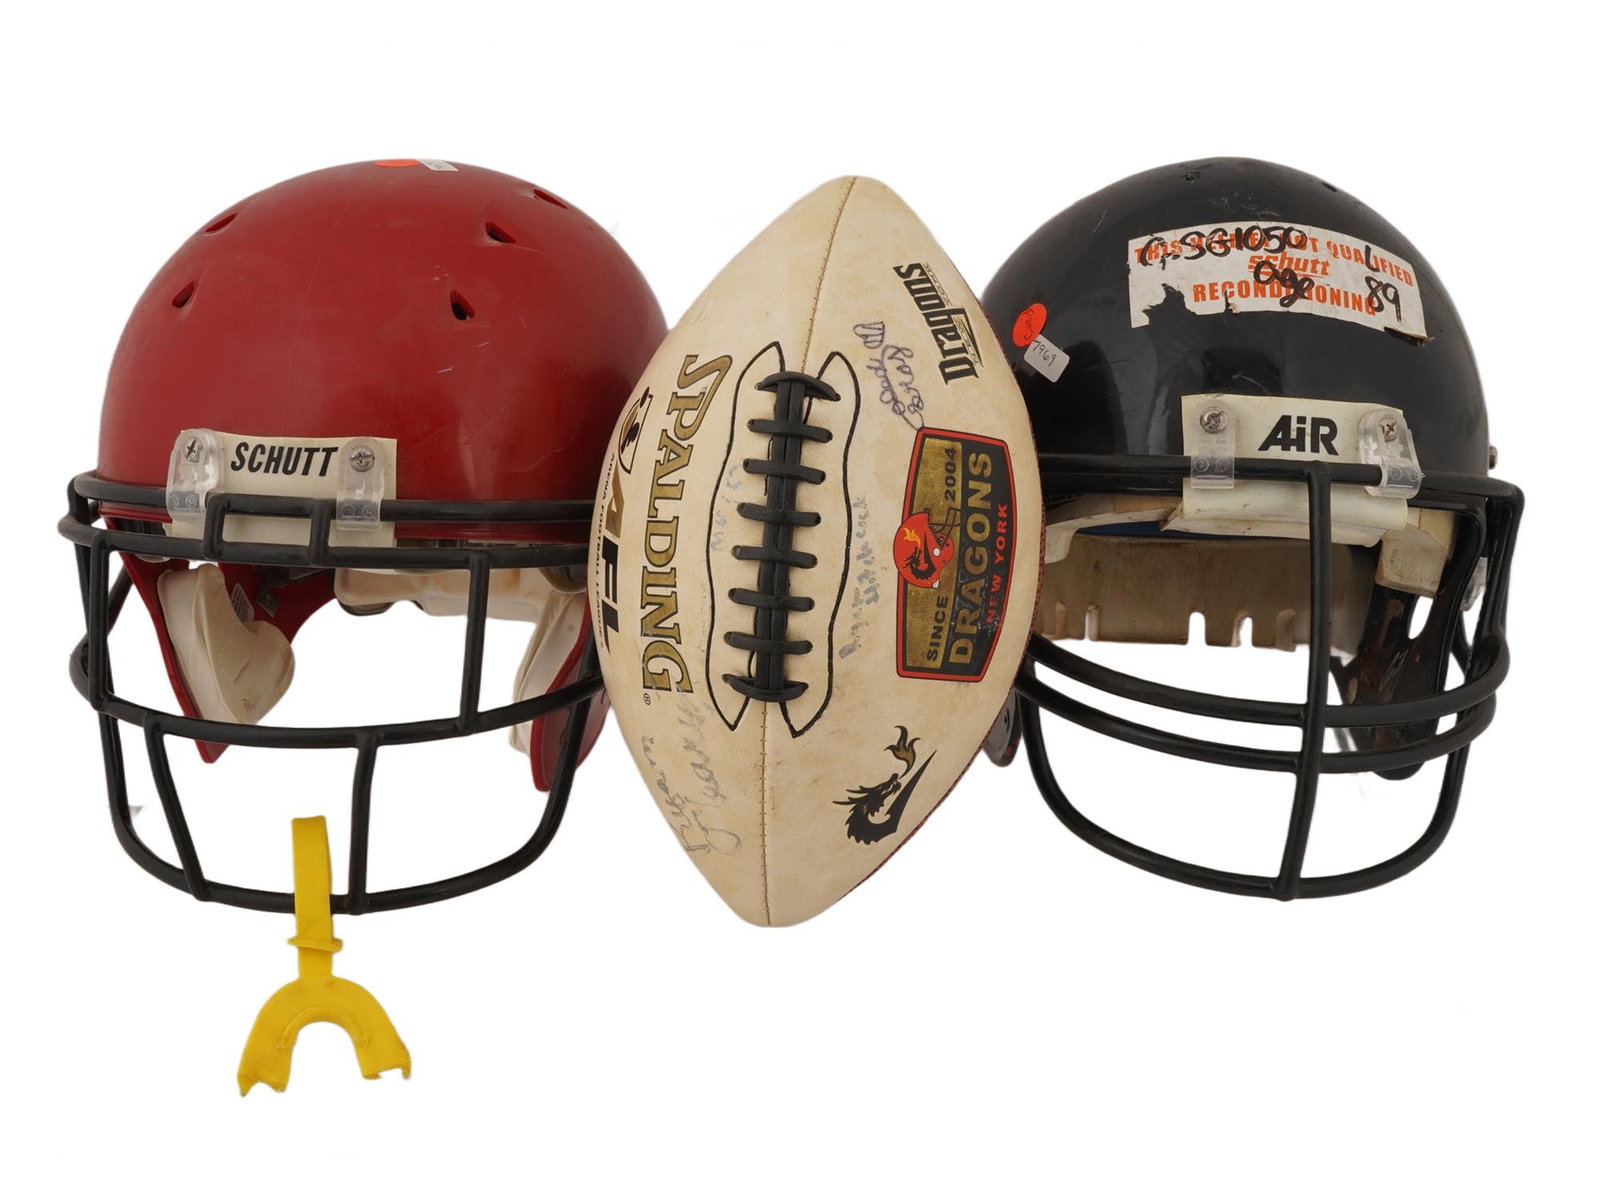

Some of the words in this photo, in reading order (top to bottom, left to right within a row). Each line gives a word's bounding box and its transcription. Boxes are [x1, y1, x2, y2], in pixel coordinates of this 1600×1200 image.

[1189, 232, 1270, 252] HLME
[1280, 233, 1319, 254] OT
[1326, 240, 1413, 287] QUAIFIED
[892, 262, 983, 386] Dragons
[1193, 278, 1377, 316] RECONDIIONING
[1364, 275, 1402, 322] 89
[230, 441, 339, 477] SCHUTT
[602, 453, 615, 501] ARENA
[640, 354, 733, 694] SPALDING
[993, 504, 1009, 566] YORK
[602, 459, 625, 655] AFL
[926, 596, 948, 663] SINCE
[944, 447, 957, 502] 2004
[948, 452, 993, 665] DRAGONS
[986, 575, 1003, 624] NEW
